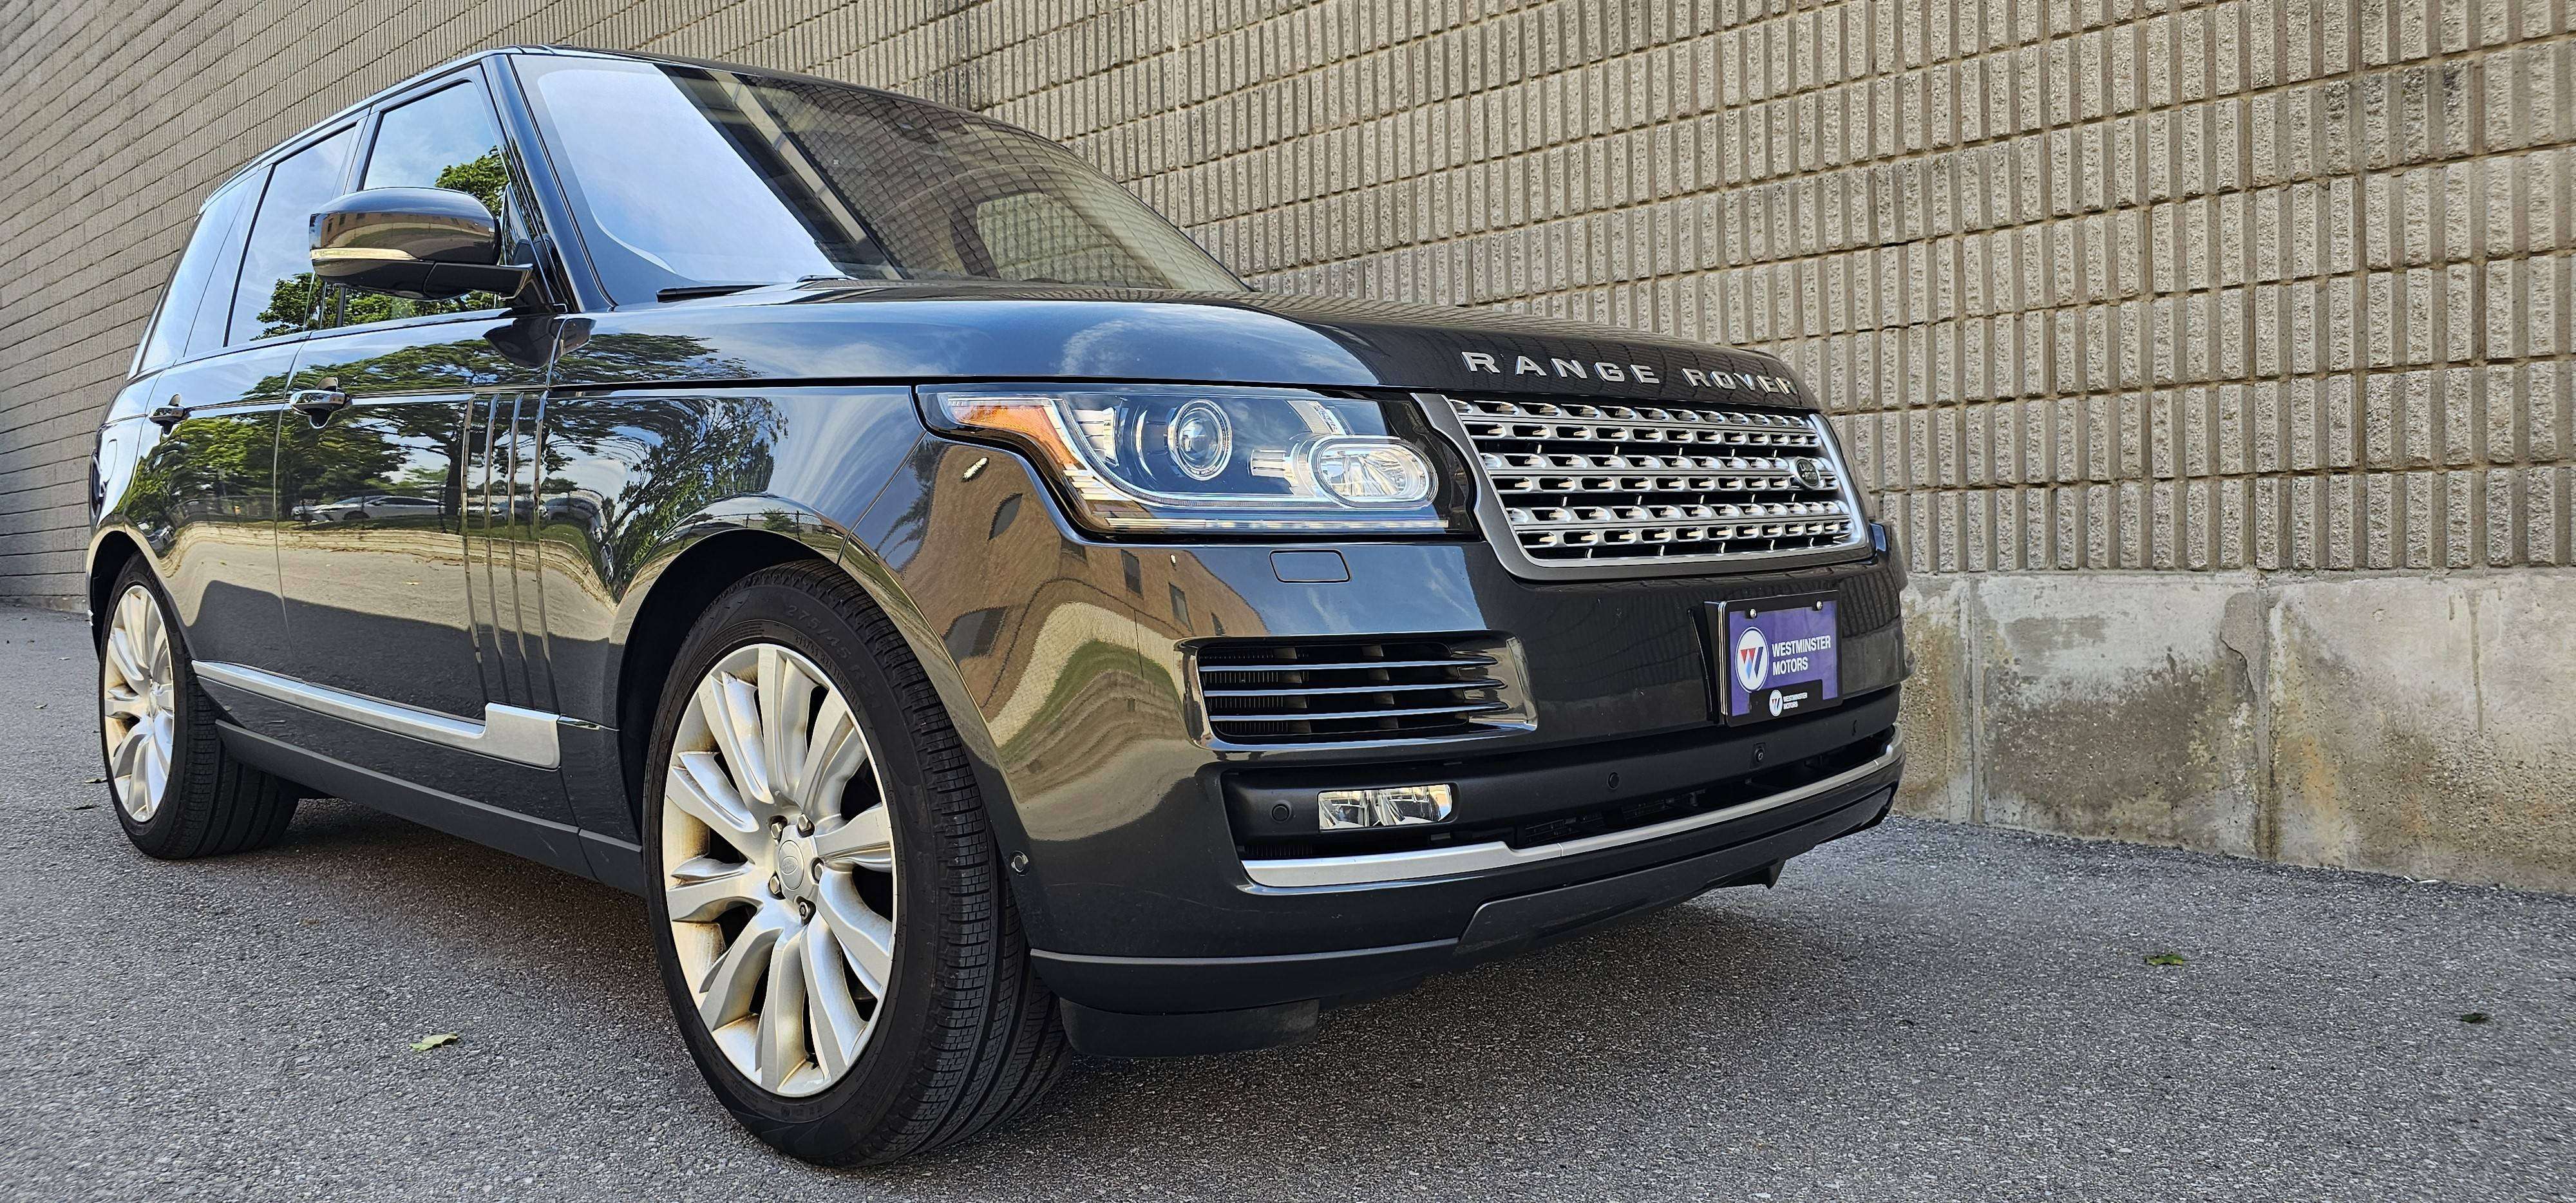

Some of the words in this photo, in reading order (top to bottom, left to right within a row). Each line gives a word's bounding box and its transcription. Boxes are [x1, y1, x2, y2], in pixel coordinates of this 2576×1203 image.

[1461, 351, 1660, 384] RANGE
[1680, 368, 1797, 395] ROVER
[788, 605, 851, 659] 275/45
[1772, 635, 1831, 658] WESTMINSTER
[1772, 657, 1808, 676] MOTORS
